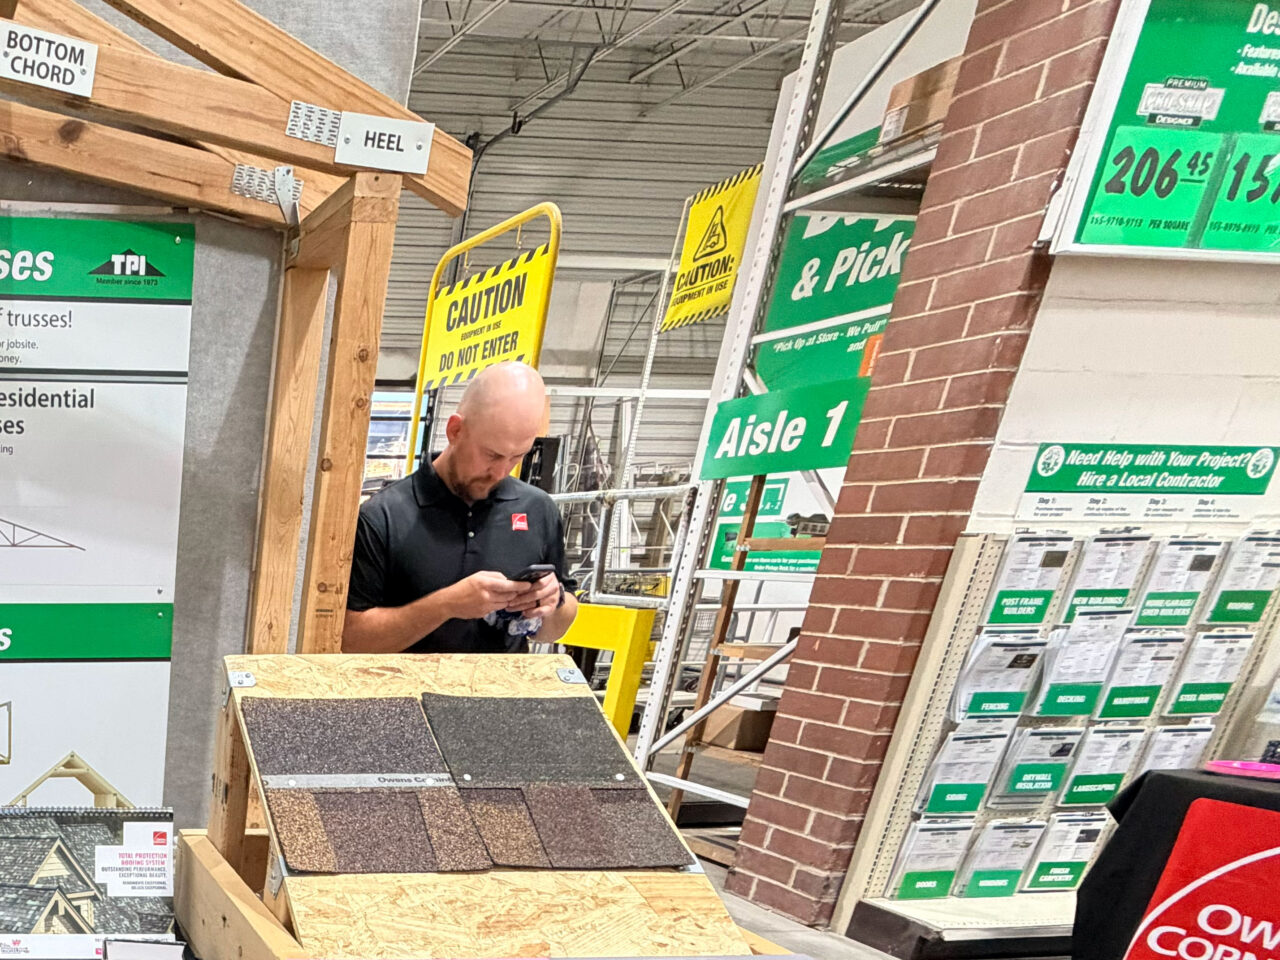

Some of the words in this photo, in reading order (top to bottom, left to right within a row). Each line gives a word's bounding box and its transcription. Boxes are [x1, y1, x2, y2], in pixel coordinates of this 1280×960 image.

[6, 29, 84, 66] BOTTOM
[10, 55, 75, 86] CHORD
[1165, 77, 1207, 89] PREMIUM
[363, 129, 404, 152] HEEL
[1104, 145, 1182, 198] 206
[1186, 150, 1214, 178] 45
[110, 253, 146, 276] TPI
[675, 254, 735, 292] CAUTION:
[790, 257, 821, 301] &
[823, 230, 911, 293] Pick
[446, 271, 527, 332] CAUTION
[670, 286, 706, 307] EQUIPMENT
[705, 284, 714, 295] IN
[713, 278, 729, 293] USE
[6, 309, 72, 328] trusses!
[460, 324, 486, 341] EQUIPMENT
[485, 322, 492, 333] IN
[491, 319, 502, 331] USE
[438, 350, 454, 372] DO
[456, 342, 480, 367] NOT
[480, 330, 519, 360] ENTER
[846, 337, 868, 353] and
[713, 409, 807, 459] Aisle
[820, 400, 848, 447] 1
[1065, 450, 1104, 465] Need
[1100, 450, 1134, 468] Help
[1133, 450, 1166, 466] with
[1166, 451, 1198, 467] Your
[1195, 451, 1252, 471] Project?
[1076, 471, 1107, 487] Hire
[1105, 473, 1118, 487] a
[1117, 472, 1158, 487] Local
[1155, 472, 1226, 488] Contractor
